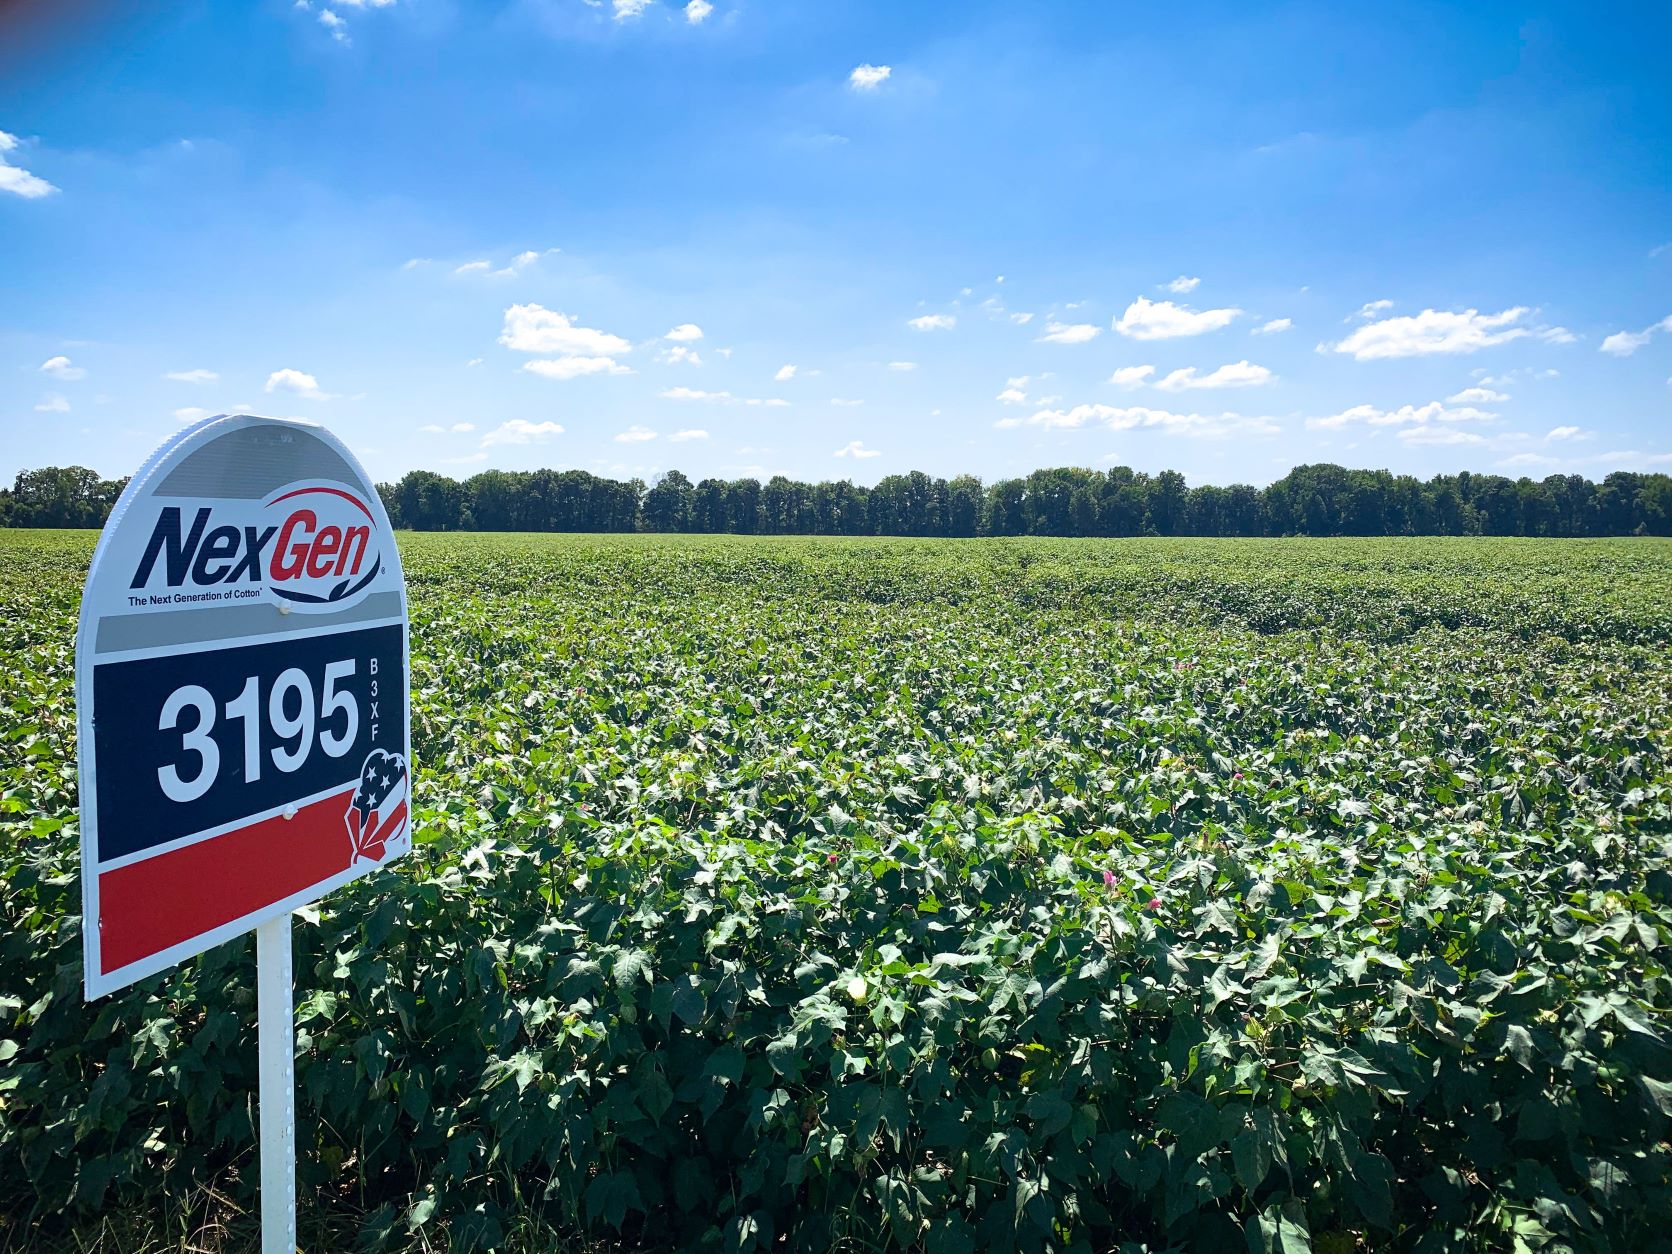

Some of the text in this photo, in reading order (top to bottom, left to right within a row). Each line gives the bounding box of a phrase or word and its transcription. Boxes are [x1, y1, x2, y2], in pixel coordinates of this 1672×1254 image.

[129, 507, 370, 589] NexGen
[128, 596, 147, 607] The
[150, 595, 172, 605] Next
[174, 591, 221, 603] Generation
[224, 590, 233, 599] of
[157, 658, 359, 803] 3195
